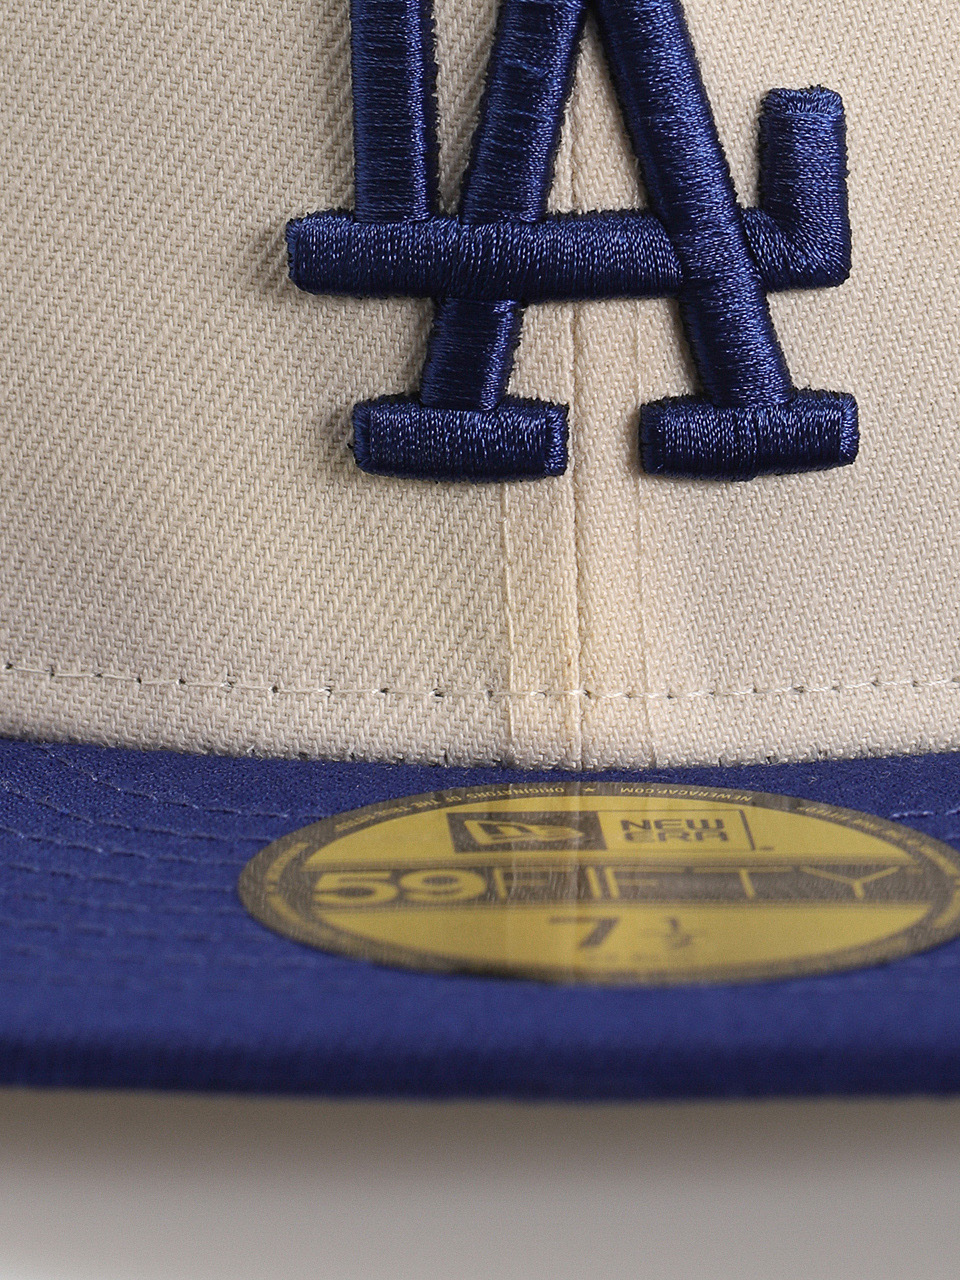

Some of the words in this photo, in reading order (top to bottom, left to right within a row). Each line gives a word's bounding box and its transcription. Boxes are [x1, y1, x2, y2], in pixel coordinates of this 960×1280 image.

[466, 787, 566, 800] ORIGINATORS
[619, 786, 753, 803] NEWERACAP.COM
[620, 818, 726, 832] NEW
[625, 830, 730, 844] ERA
[312, 865, 900, 904] 59FIFTY
[548, 916, 620, 949] 7
